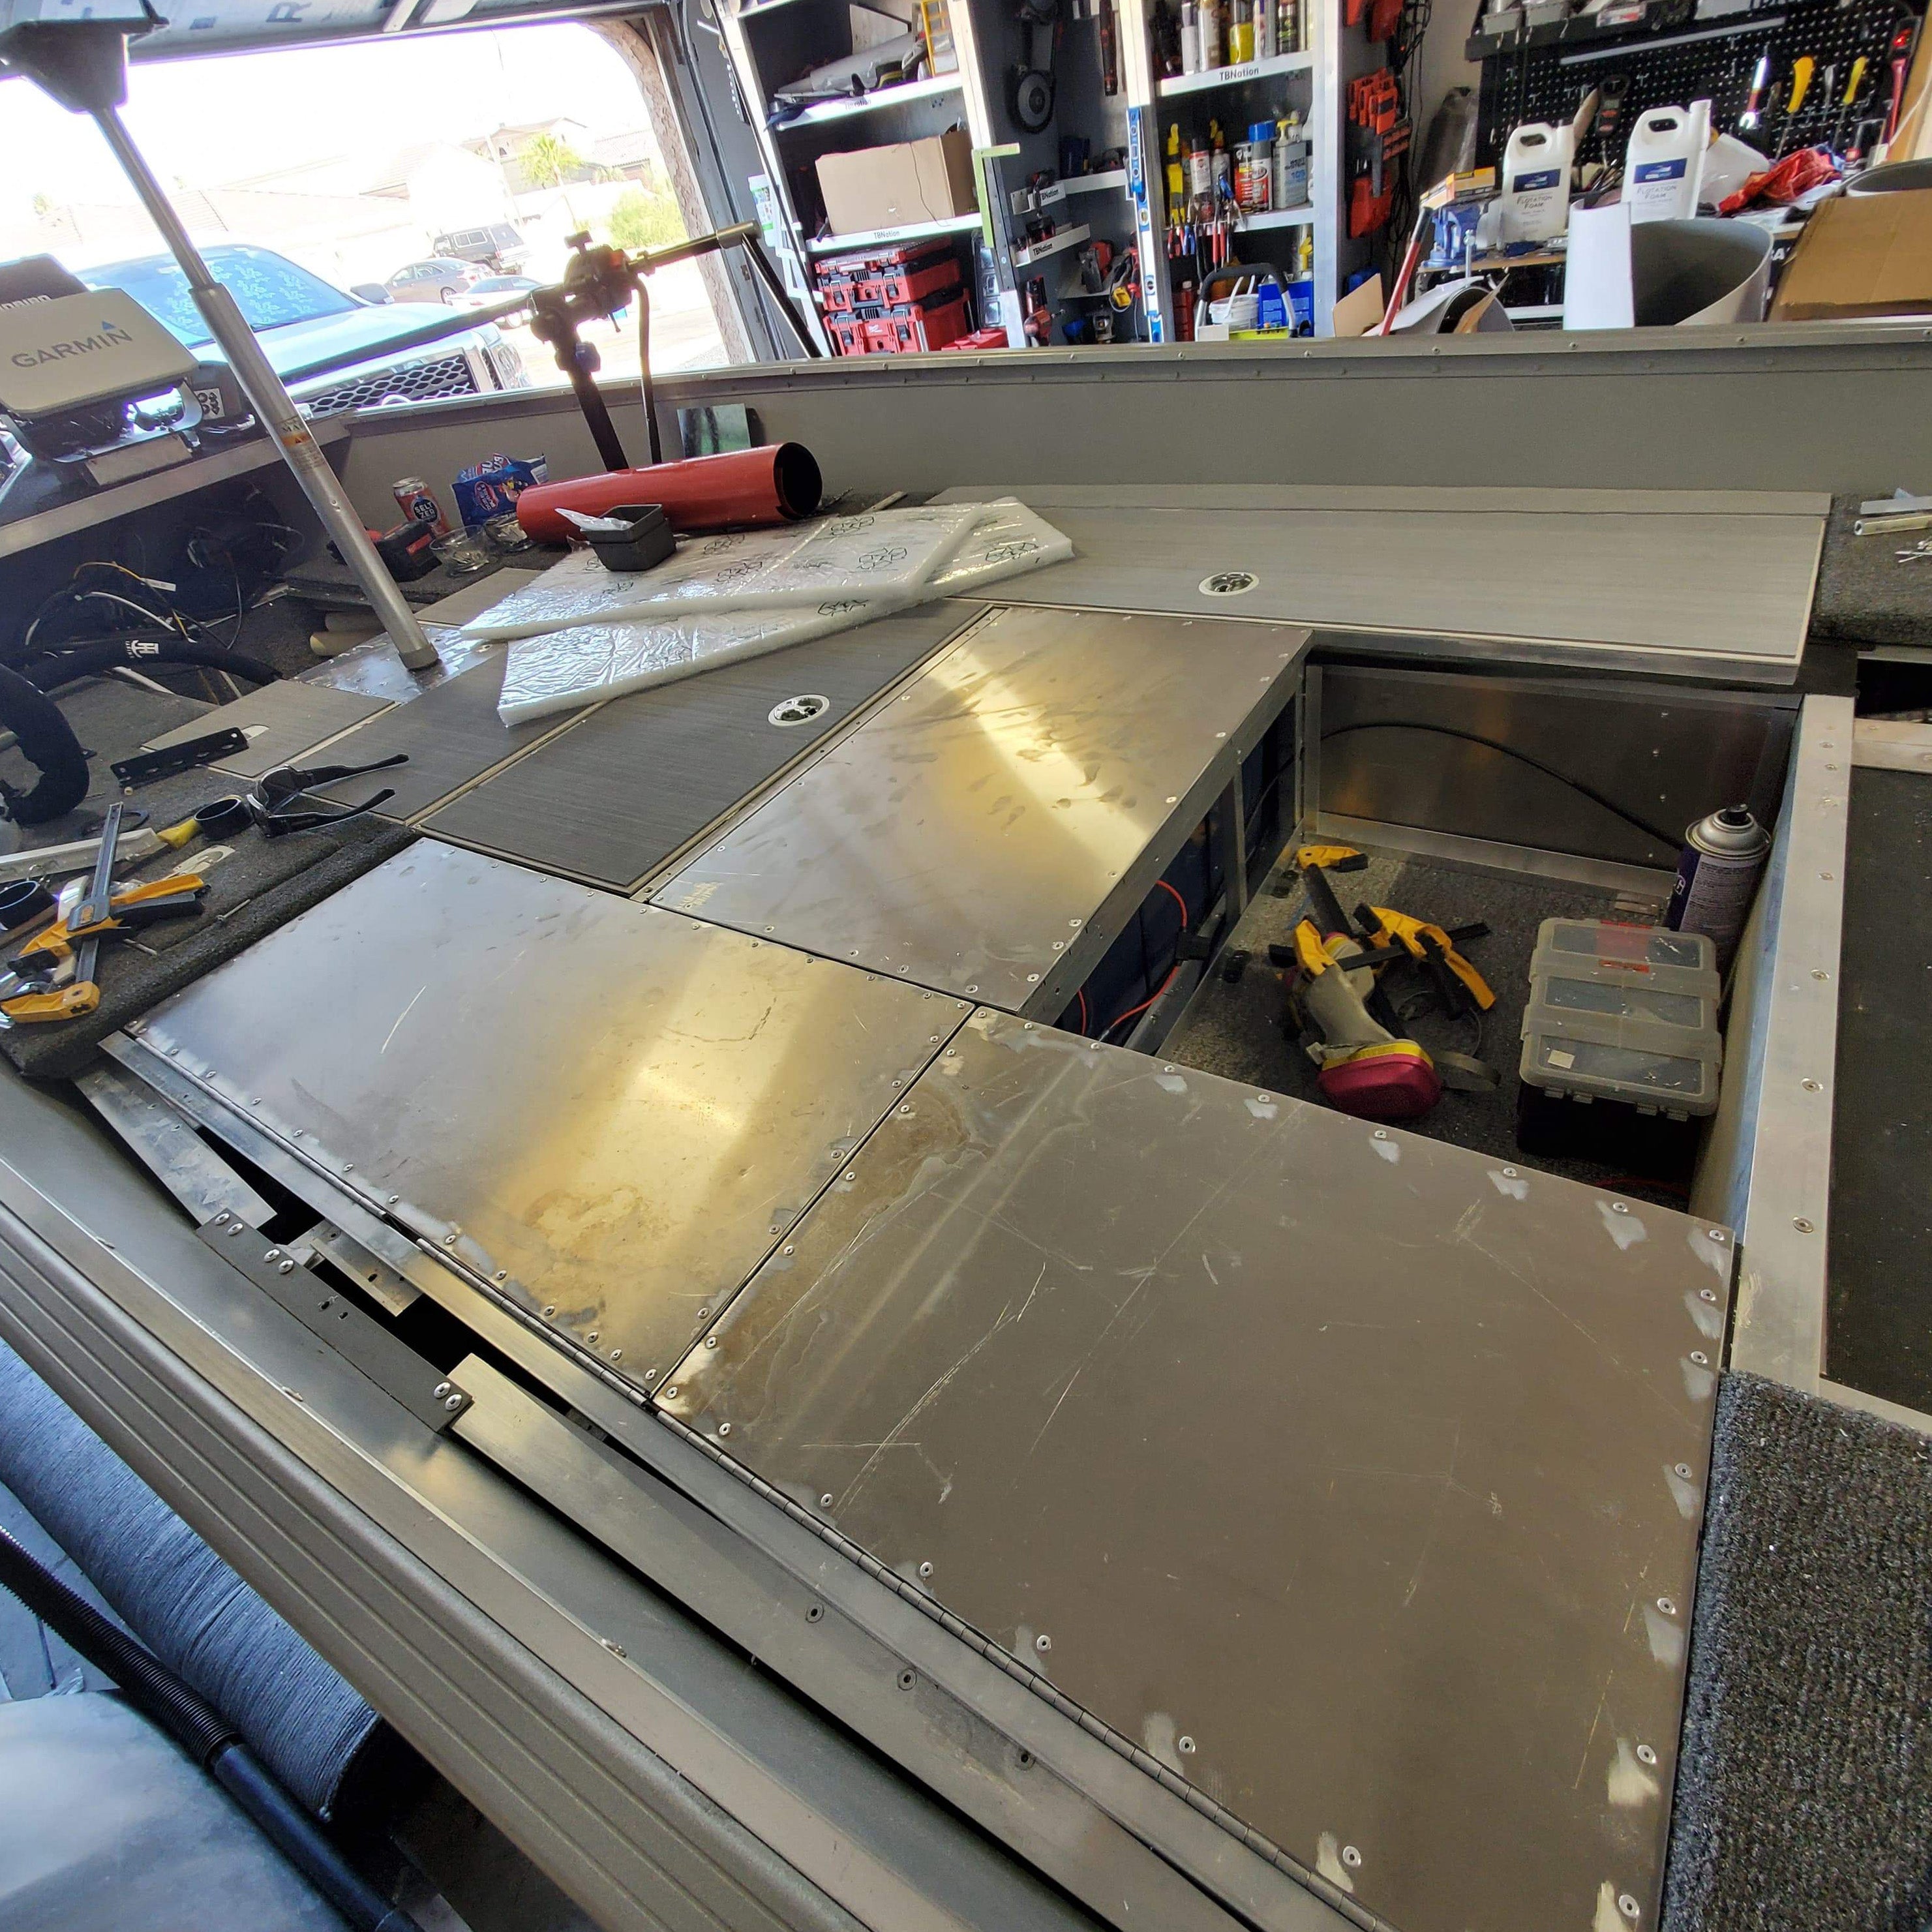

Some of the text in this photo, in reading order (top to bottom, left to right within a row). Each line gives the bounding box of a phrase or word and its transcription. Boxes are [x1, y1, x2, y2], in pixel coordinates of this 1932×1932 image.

[1219, 67, 1260, 82] TBNation
[1042, 189, 1059, 201] BNation
[874, 230, 900, 240] TBNation
[11, 329, 133, 367] GARMIN
[414, 502, 432, 513] SELT
[420, 509, 436, 519] ZER
